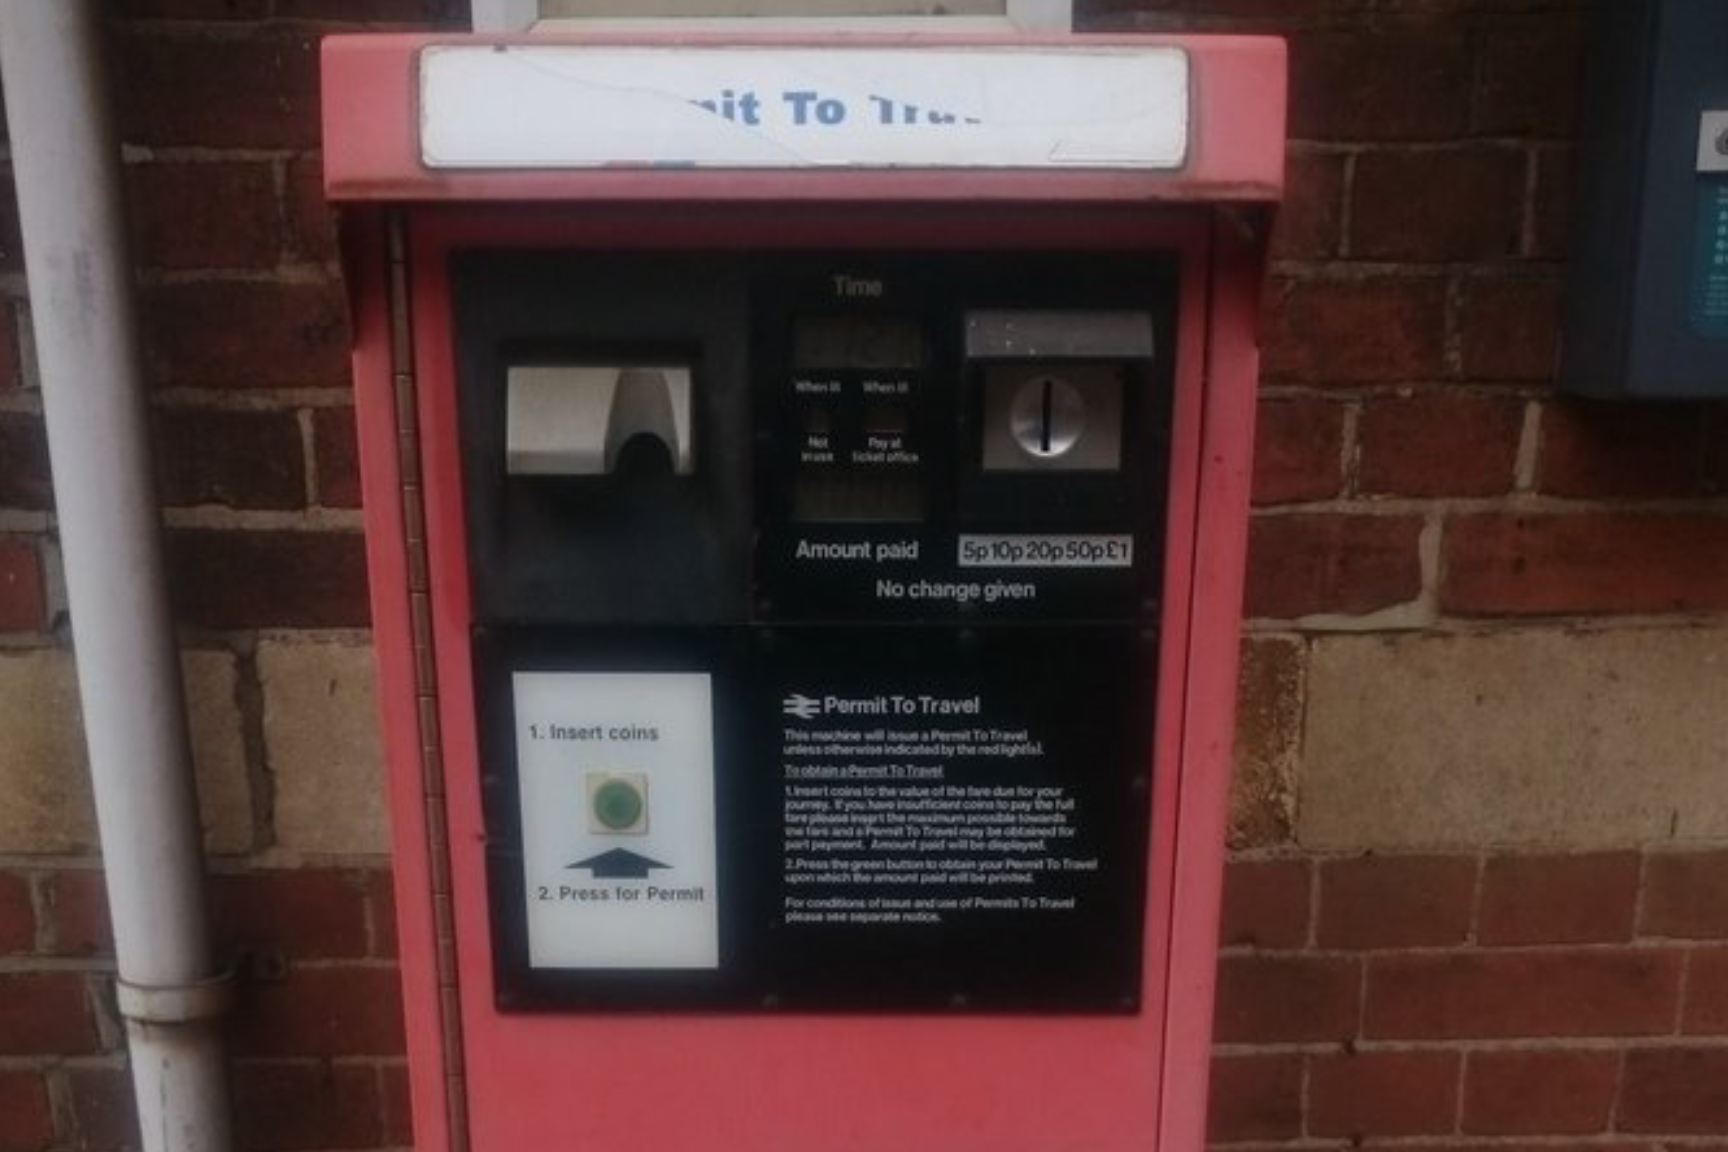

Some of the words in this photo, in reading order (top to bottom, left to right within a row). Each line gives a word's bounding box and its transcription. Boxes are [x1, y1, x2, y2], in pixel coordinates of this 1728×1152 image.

[783, 91, 846, 125] To
[832, 274, 883, 297] Time
[794, 380, 828, 393] When
[862, 380, 896, 394] When
[807, 436, 829, 449] Not
[867, 437, 889, 451] Pay
[890, 437, 902, 449] at
[852, 451, 886, 463] ticket
[887, 452, 920, 464] office
[796, 539, 872, 560] Amount
[876, 540, 920, 563] paid
[876, 579, 904, 598] No
[908, 579, 981, 602] change
[983, 579, 1036, 602] given
[824, 695, 888, 714] Permit
[890, 696, 916, 714] To
[918, 695, 980, 714] Travel
[529, 724, 545, 740] 1.
[549, 723, 603, 741] Insert
[608, 723, 659, 741] coins
[785, 729, 809, 742] This
[812, 729, 861, 742] machine
[864, 729, 885, 742] will
[887, 729, 919, 742] issue
[931, 729, 971, 742] Permit
[990, 729, 1028, 742] Travel
[783, 743, 821, 755] unless
[824, 743, 882, 755] otherwise
[884, 743, 940, 755] indicated
[957, 743, 976, 755] the
[978, 743, 999, 755] red
[801, 764, 838, 778] obtain
[848, 764, 888, 778] Permit
[906, 764, 944, 778] Travel
[830, 786, 862, 797] coins
[879, 786, 898, 797] the
[900, 786, 930, 797] value
[946, 786, 966, 797] the
[967, 786, 992, 797] fare
[993, 786, 1015, 797] due
[1016, 786, 1034, 797] for
[1036, 788, 1064, 800] your
[844, 801, 867, 812] you
[868, 800, 896, 810] have
[897, 800, 961, 810] insufficient
[962, 800, 994, 810] coins
[1011, 801, 1032, 812] pay
[1034, 800, 1054, 810] the
[1056, 800, 1075, 810] full
[785, 813, 807, 823] fare
[808, 813, 849, 826] please
[850, 813, 885, 823] insert
[886, 813, 906, 823] the
[907, 813, 966, 823] maximum
[967, 813, 1016, 826] possible
[1018, 813, 1067, 823] towards
[785, 827, 804, 838] the
[805, 827, 830, 838] fare
[831, 827, 854, 838] and
[866, 827, 904, 838] Permit
[922, 827, 958, 838] Travel
[959, 828, 984, 840] may
[1003, 827, 1056, 838] obtained
[1057, 827, 1075, 838] for
[785, 840, 810, 852] part
[870, 840, 917, 850] Amount
[919, 840, 946, 852] paid
[947, 840, 968, 850] will
[831, 859, 849, 869] the
[850, 861, 885, 872] green
[886, 859, 924, 869] button
[938, 859, 977, 869] obtain
[979, 861, 1003, 872] your
[1005, 859, 1044, 869] Permit
[1062, 859, 1098, 869] Travel
[785, 874, 816, 885] upon
[817, 872, 851, 883] which
[852, 872, 872, 883] the
[873, 872, 919, 883] amount
[920, 872, 947, 885] paid
[948, 872, 969, 883] will
[538, 885, 554, 901] 2.
[559, 886, 610, 901] Press
[616, 886, 641, 901] for
[647, 886, 704, 902] Permit
[785, 897, 805, 908] For
[806, 897, 867, 908] conditions
[881, 897, 912, 908] issue
[913, 897, 935, 908] and
[936, 900, 958, 908] use
[974, 897, 1020, 908] Permits
[1039, 897, 1075, 908] Travel
[785, 911, 824, 923] please
[826, 913, 847, 921] see
[849, 911, 901, 923] separate
